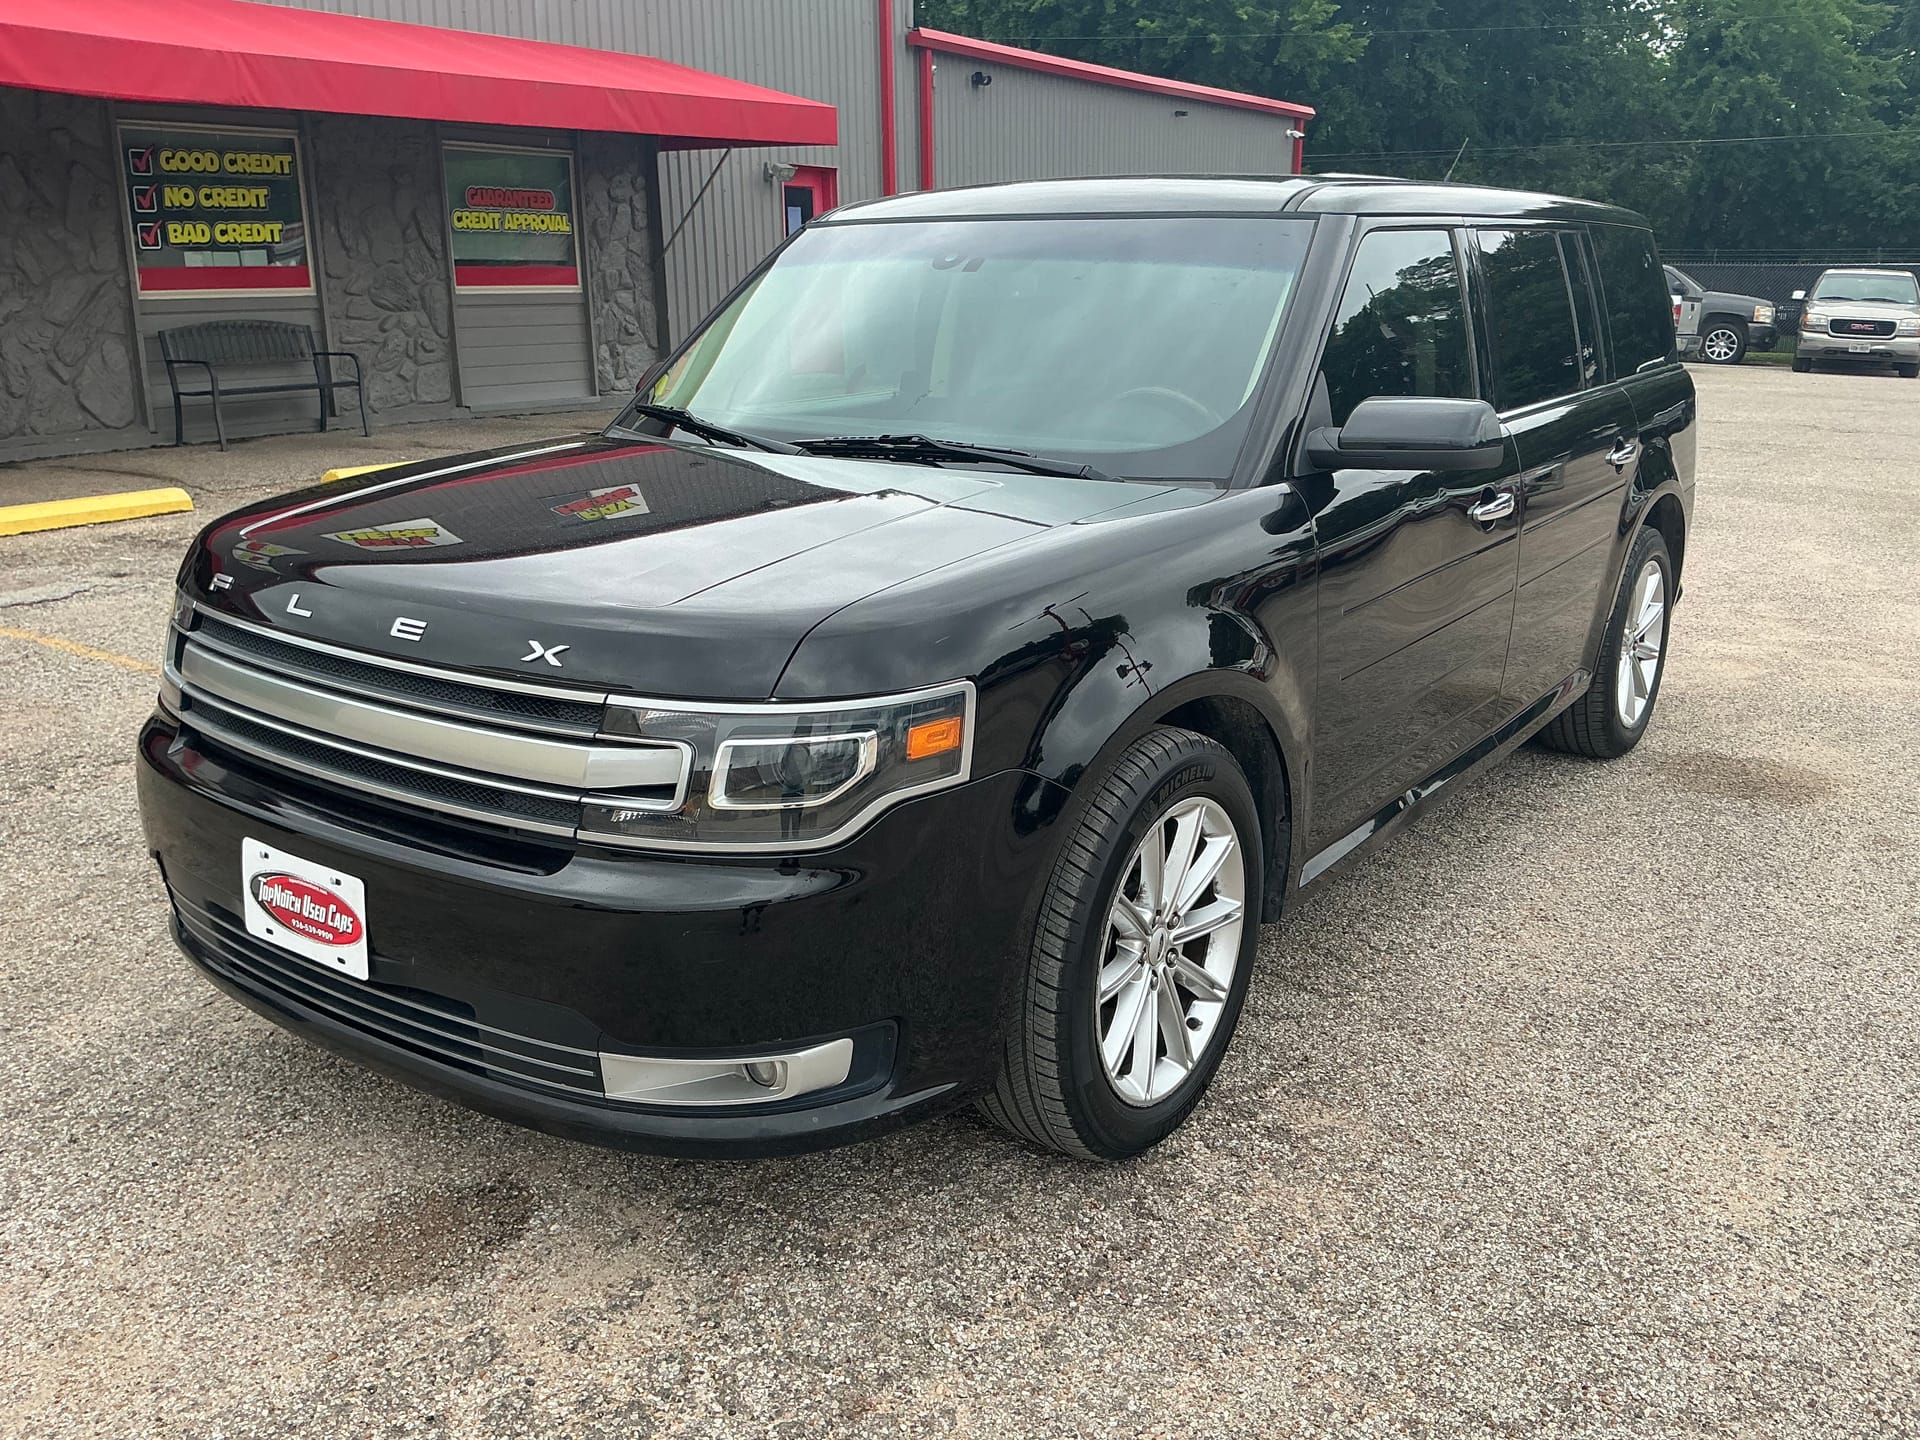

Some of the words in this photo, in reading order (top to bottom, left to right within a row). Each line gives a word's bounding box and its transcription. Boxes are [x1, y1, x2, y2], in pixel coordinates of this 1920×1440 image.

[159, 150, 220, 172] GOOD
[223, 153, 292, 174] CREDIT
[164, 186, 195, 207] NO
[198, 187, 268, 209] CREDIT
[467, 187, 553, 210] GUARANTEED
[167, 222, 211, 243] BAD
[214, 223, 282, 244] CREDIT
[453, 211, 501, 229] CREDIT
[504, 213, 570, 232] APPROVAL
[1850, 323, 1875, 331] GMC
[208, 572, 571, 667] FLEX
[1159, 763, 1216, 800] MICHELIN
